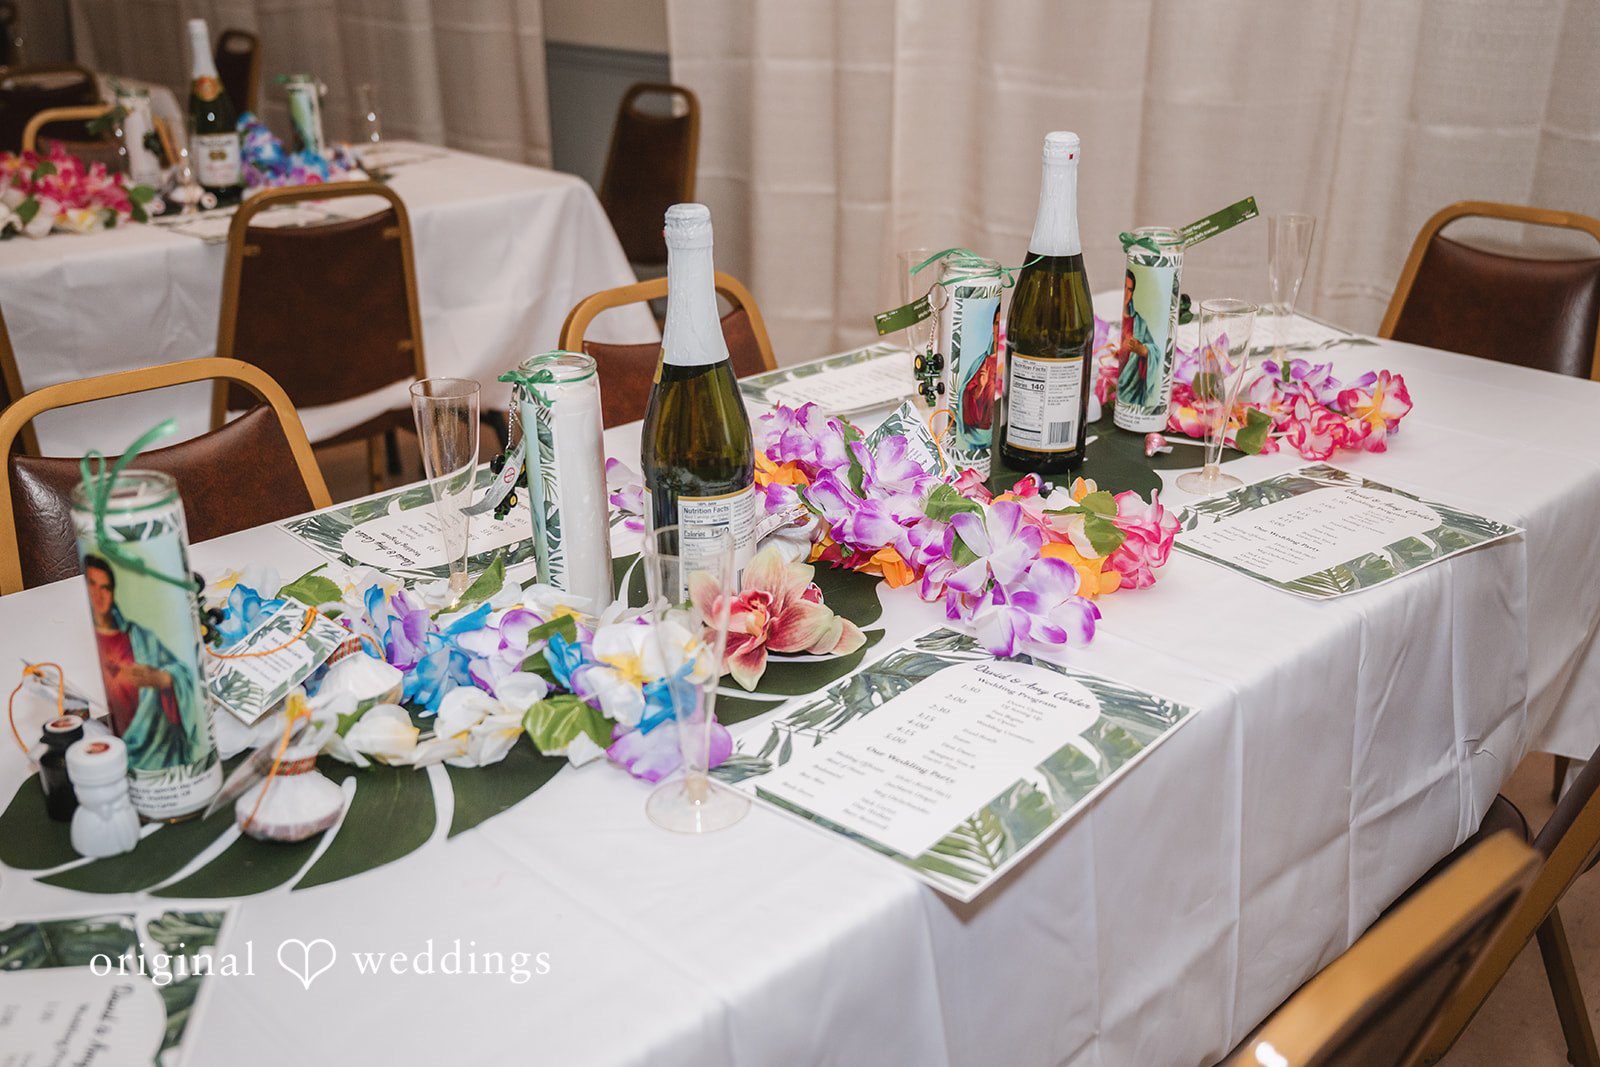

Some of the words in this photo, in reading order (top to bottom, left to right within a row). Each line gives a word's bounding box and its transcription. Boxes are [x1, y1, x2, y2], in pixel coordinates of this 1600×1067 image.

[683, 506, 712, 514] Nutrition
[973, 664, 1012, 680] David
[1020, 682, 1050, 695] Amy
[1053, 691, 1092, 709] Carter
[978, 677, 1016, 695] Wedding
[1018, 691, 1057, 708] Program
[866, 746, 886, 757] Our
[888, 753, 929, 774] Wedding
[930, 769, 955, 783] Party
